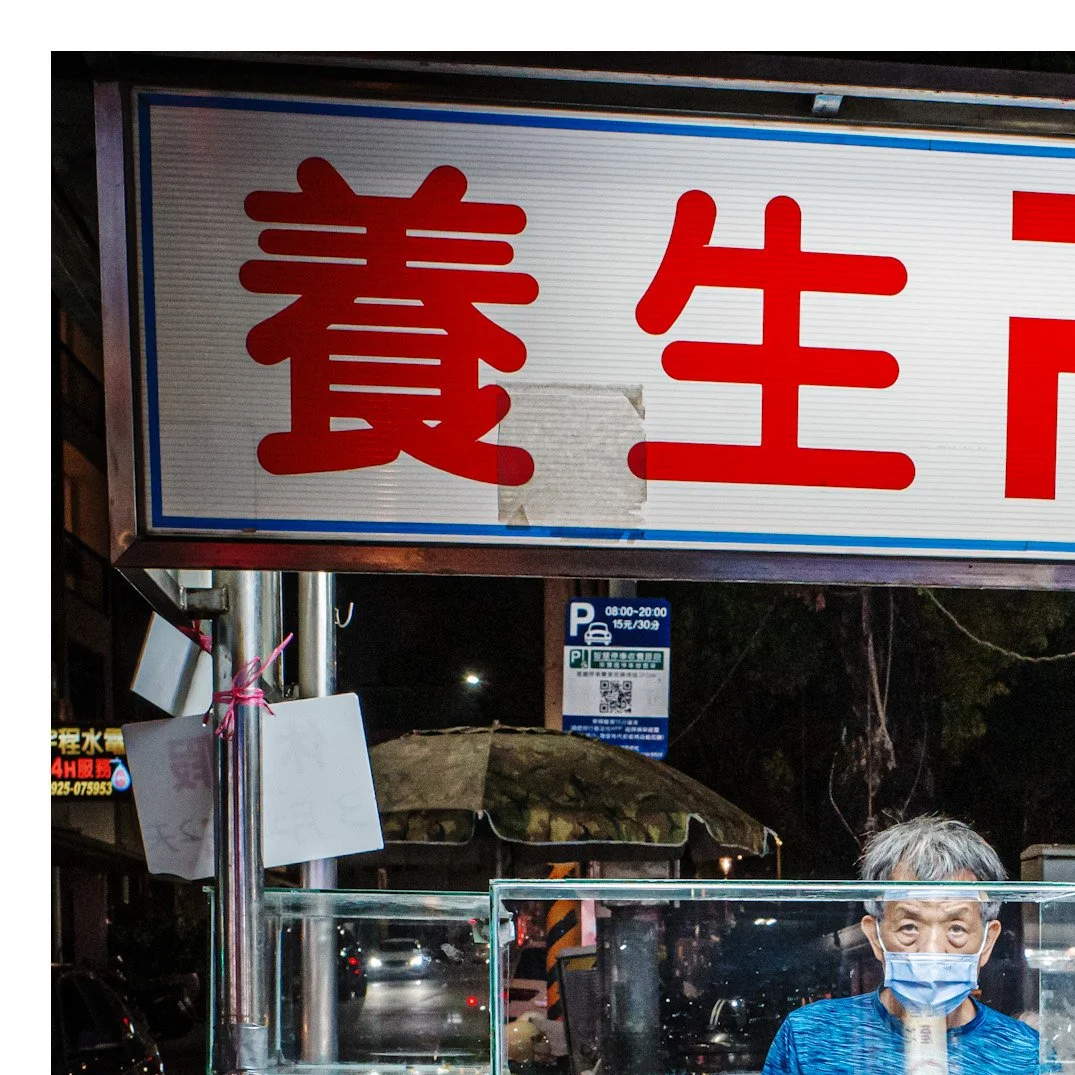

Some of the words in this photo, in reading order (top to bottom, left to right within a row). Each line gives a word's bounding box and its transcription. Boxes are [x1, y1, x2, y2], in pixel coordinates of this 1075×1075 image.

[570, 602, 595, 637] P
[605, 606, 667, 617] 08:00~20:00
[612, 619, 660, 631] 15元/30分
[51, 727, 126, 755] 程水電
